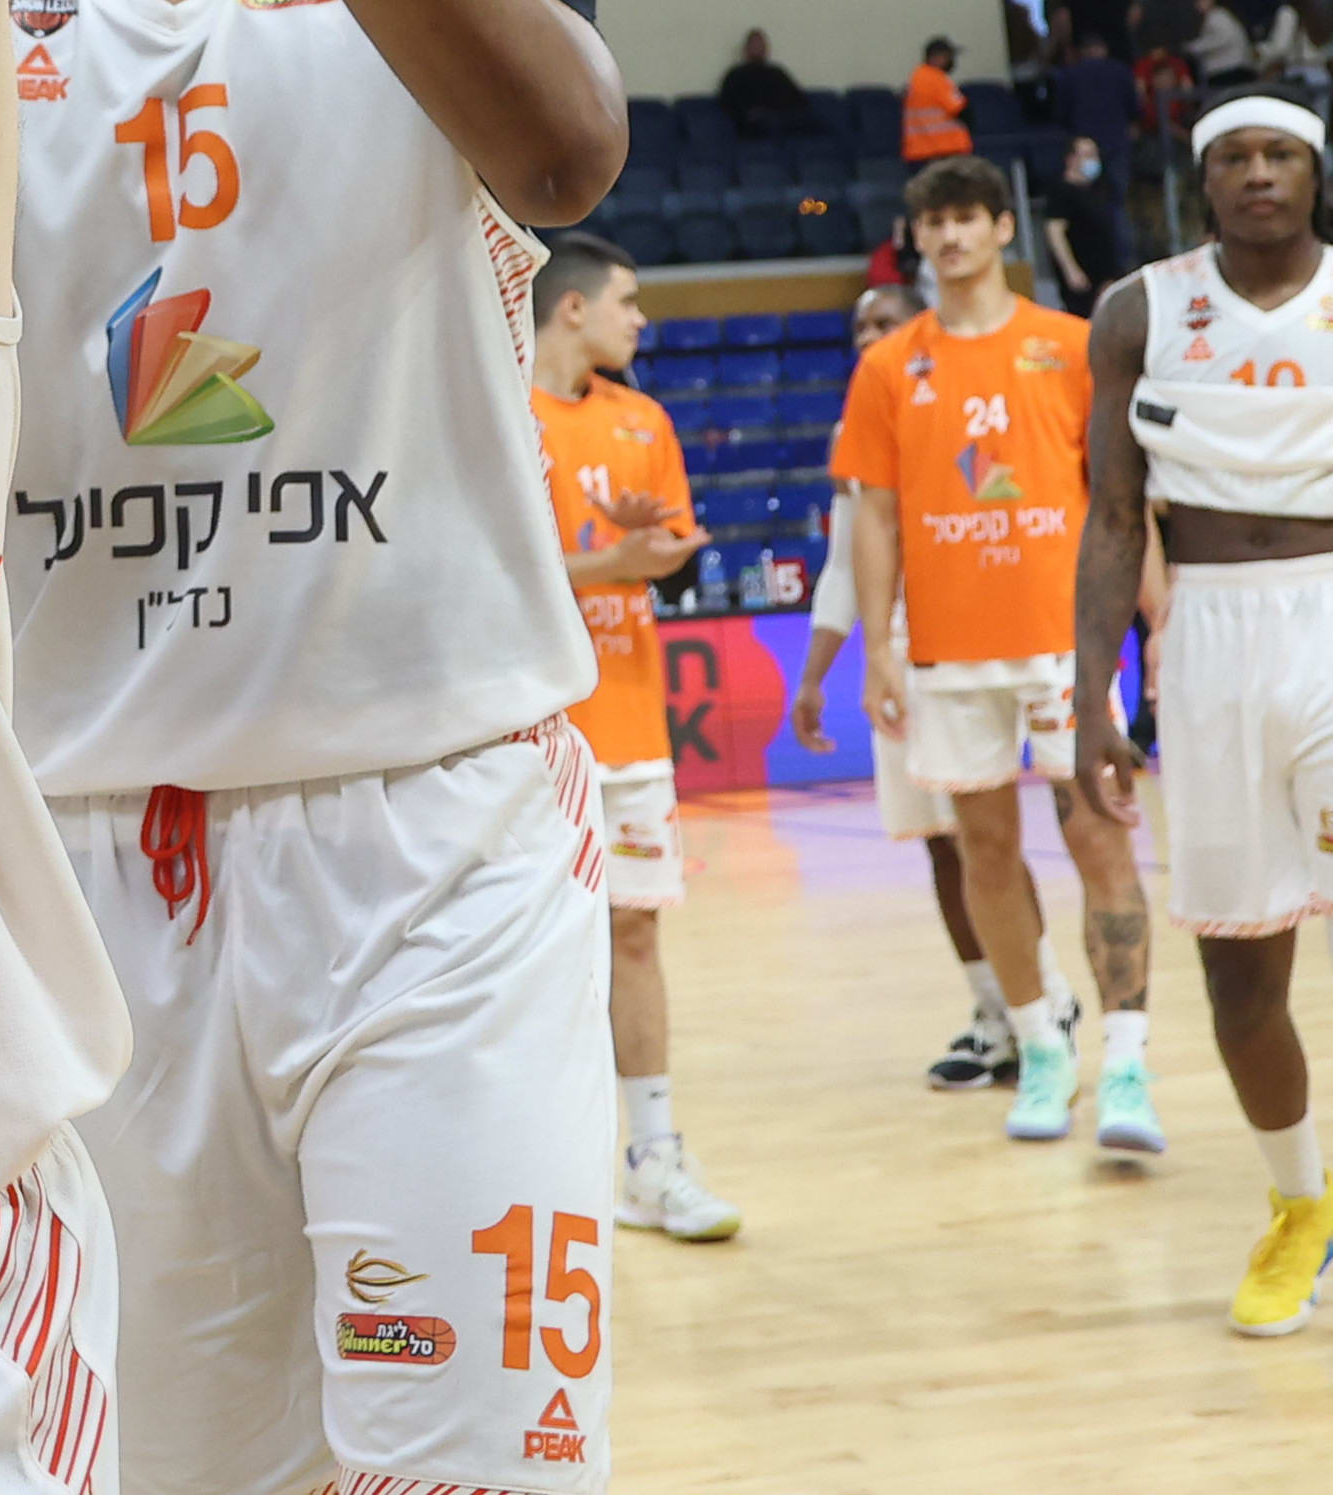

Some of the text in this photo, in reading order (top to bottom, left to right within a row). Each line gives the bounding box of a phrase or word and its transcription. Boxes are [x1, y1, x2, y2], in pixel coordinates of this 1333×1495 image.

[114, 83, 241, 243] 15
[963, 394, 1010, 437] 24
[247, 470, 388, 544] אפי
[471, 1203, 602, 1379] 15
[523, 1430, 587, 1464] PEAK
